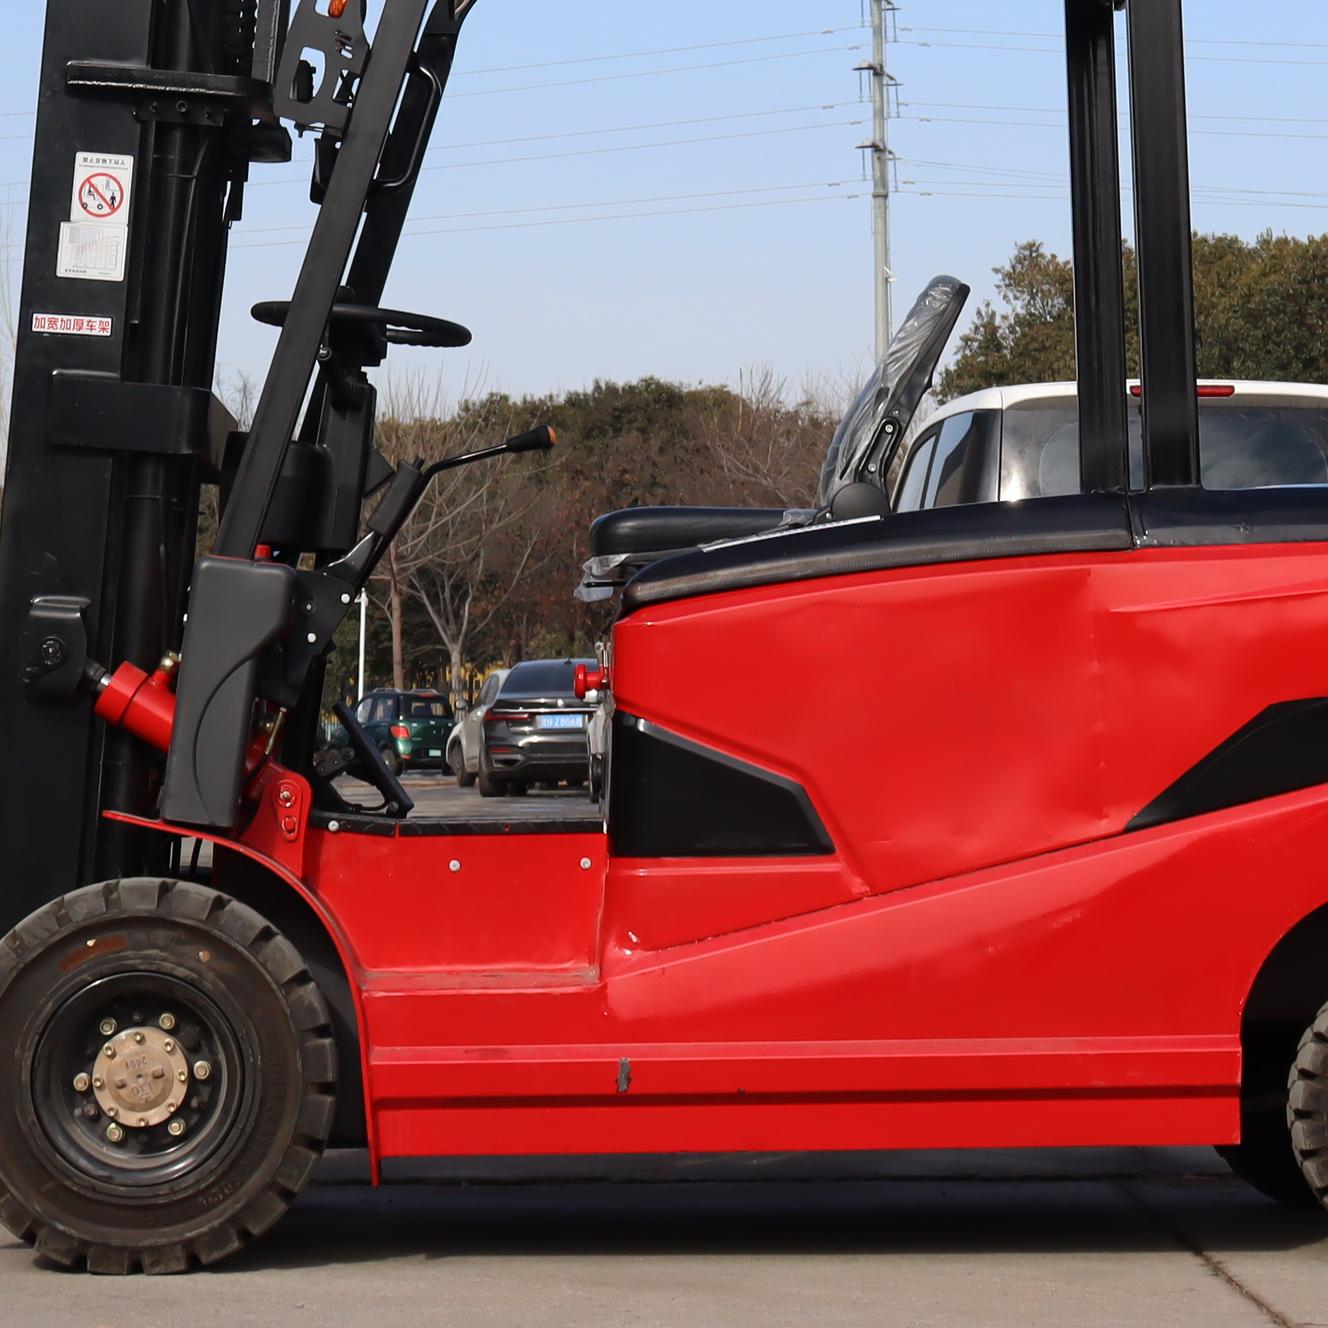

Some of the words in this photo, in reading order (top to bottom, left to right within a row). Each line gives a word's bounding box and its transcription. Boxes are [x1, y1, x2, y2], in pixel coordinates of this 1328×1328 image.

[33, 316, 110, 333] 加宽加厚车架
